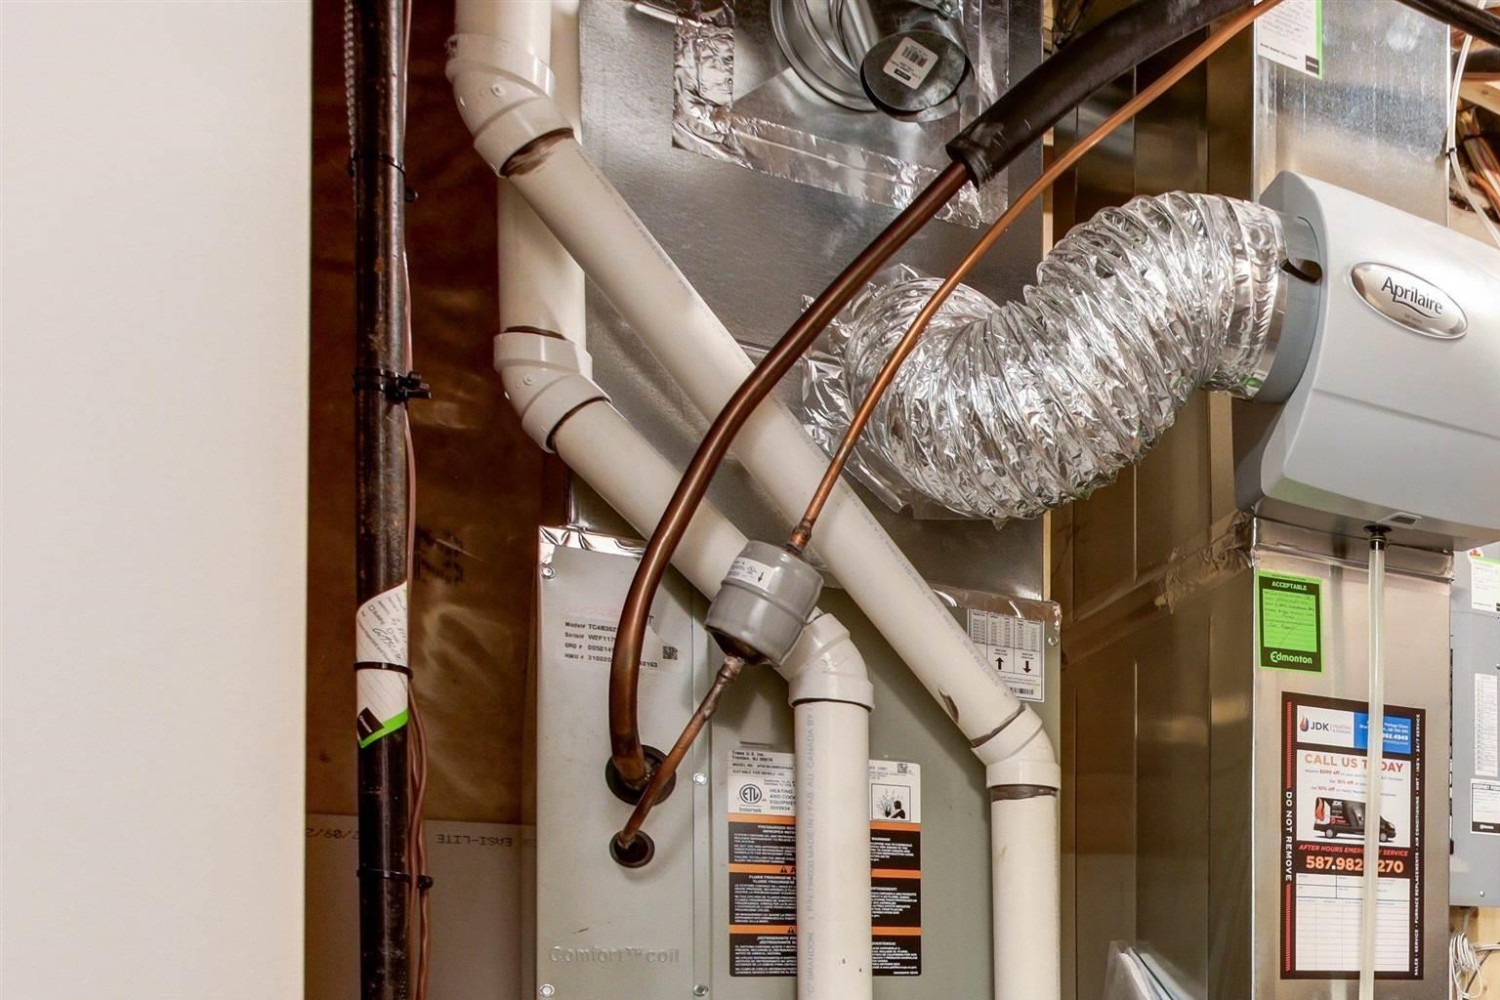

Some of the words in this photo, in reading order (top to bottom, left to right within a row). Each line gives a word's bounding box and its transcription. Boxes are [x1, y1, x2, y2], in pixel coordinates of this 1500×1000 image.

[1381, 276, 1442, 314] Aprilaire
[1272, 581, 1307, 591] ACCEPTABLE
[1270, 651, 1312, 664] Edmonton
[1311, 722, 1329, 731] JDK
[1305, 754, 1337, 766] CALL
[1342, 757, 1358, 768] US
[1362, 759, 1403, 773] TDAY
[1286, 792, 1292, 806] DO
[436, 833, 513, 848] EASI-LITE
[1306, 856, 1404, 873] 587.982270
[645, 948, 679, 963] coil
